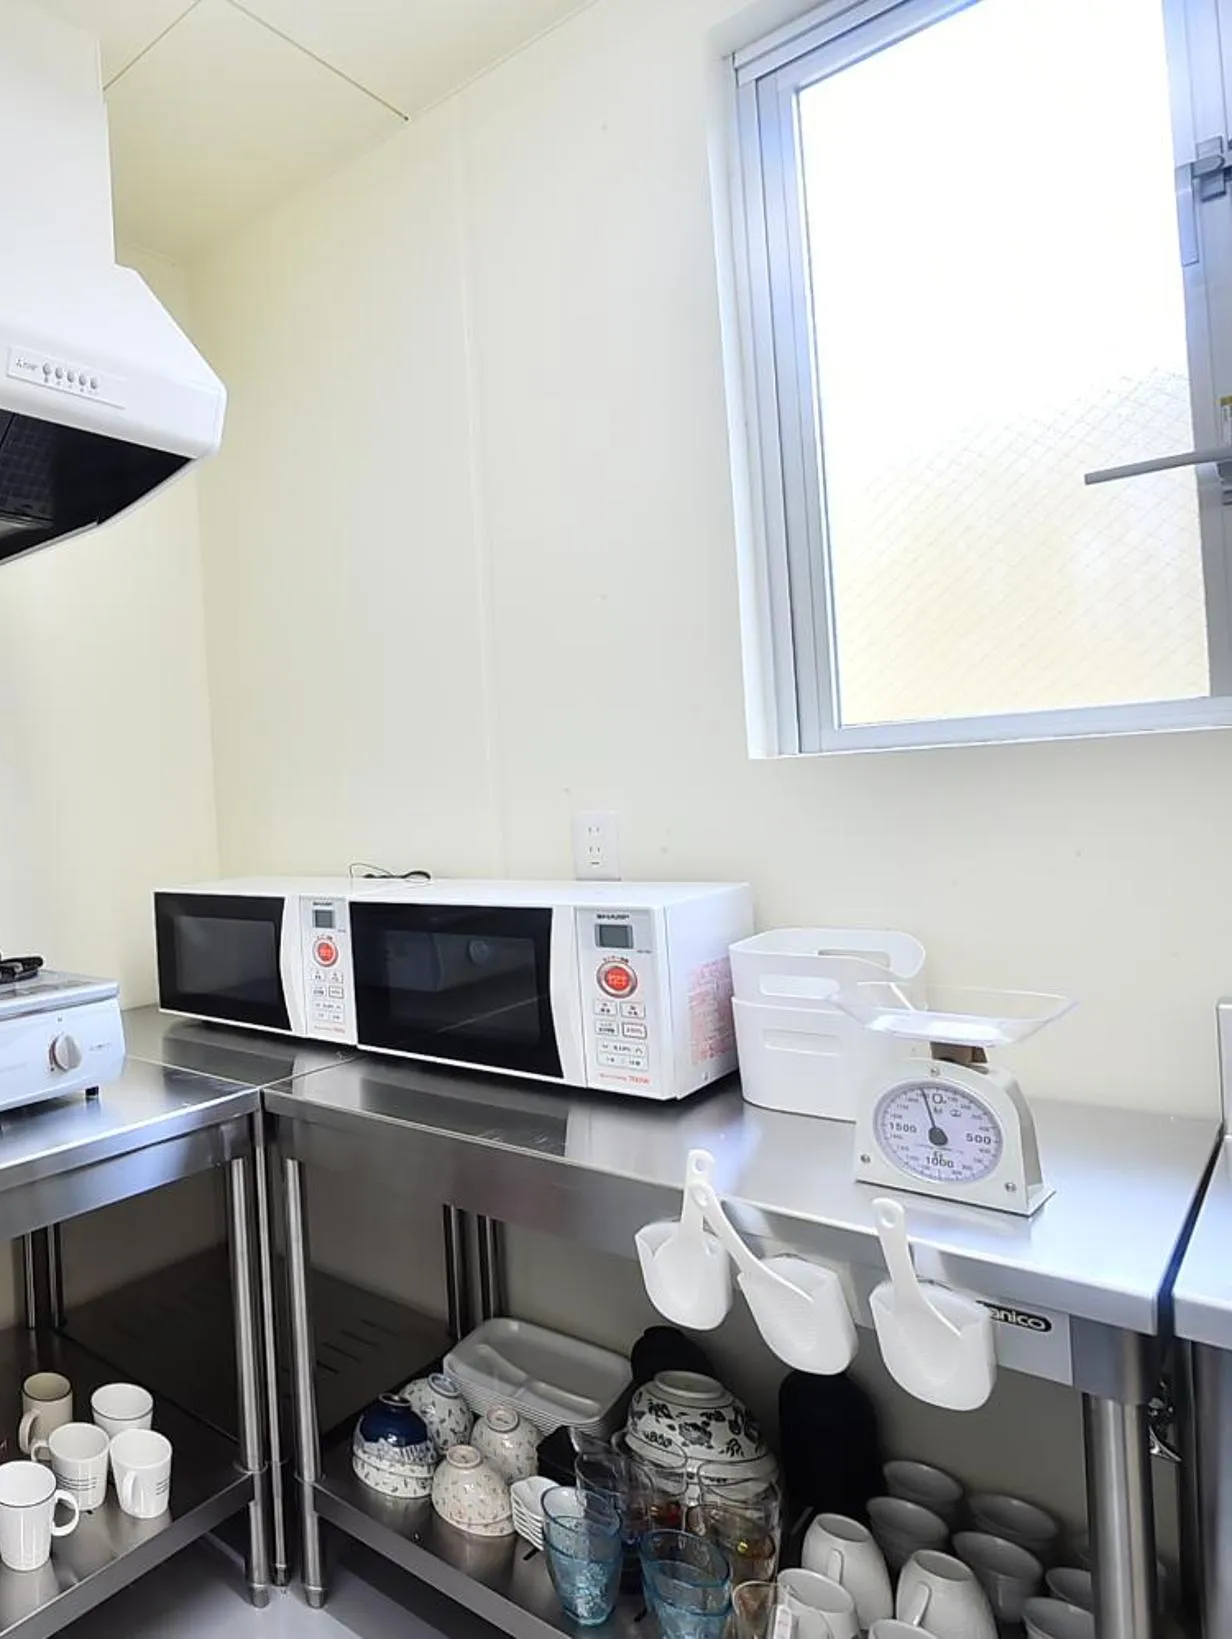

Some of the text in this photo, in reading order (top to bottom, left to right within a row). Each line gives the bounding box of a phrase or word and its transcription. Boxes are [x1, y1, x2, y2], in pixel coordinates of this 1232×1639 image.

[889, 1122, 917, 1133] 1500
[966, 1133, 992, 1145] 500
[925, 1156, 954, 1168] 1000
[990, 1307, 1046, 1330] anico
